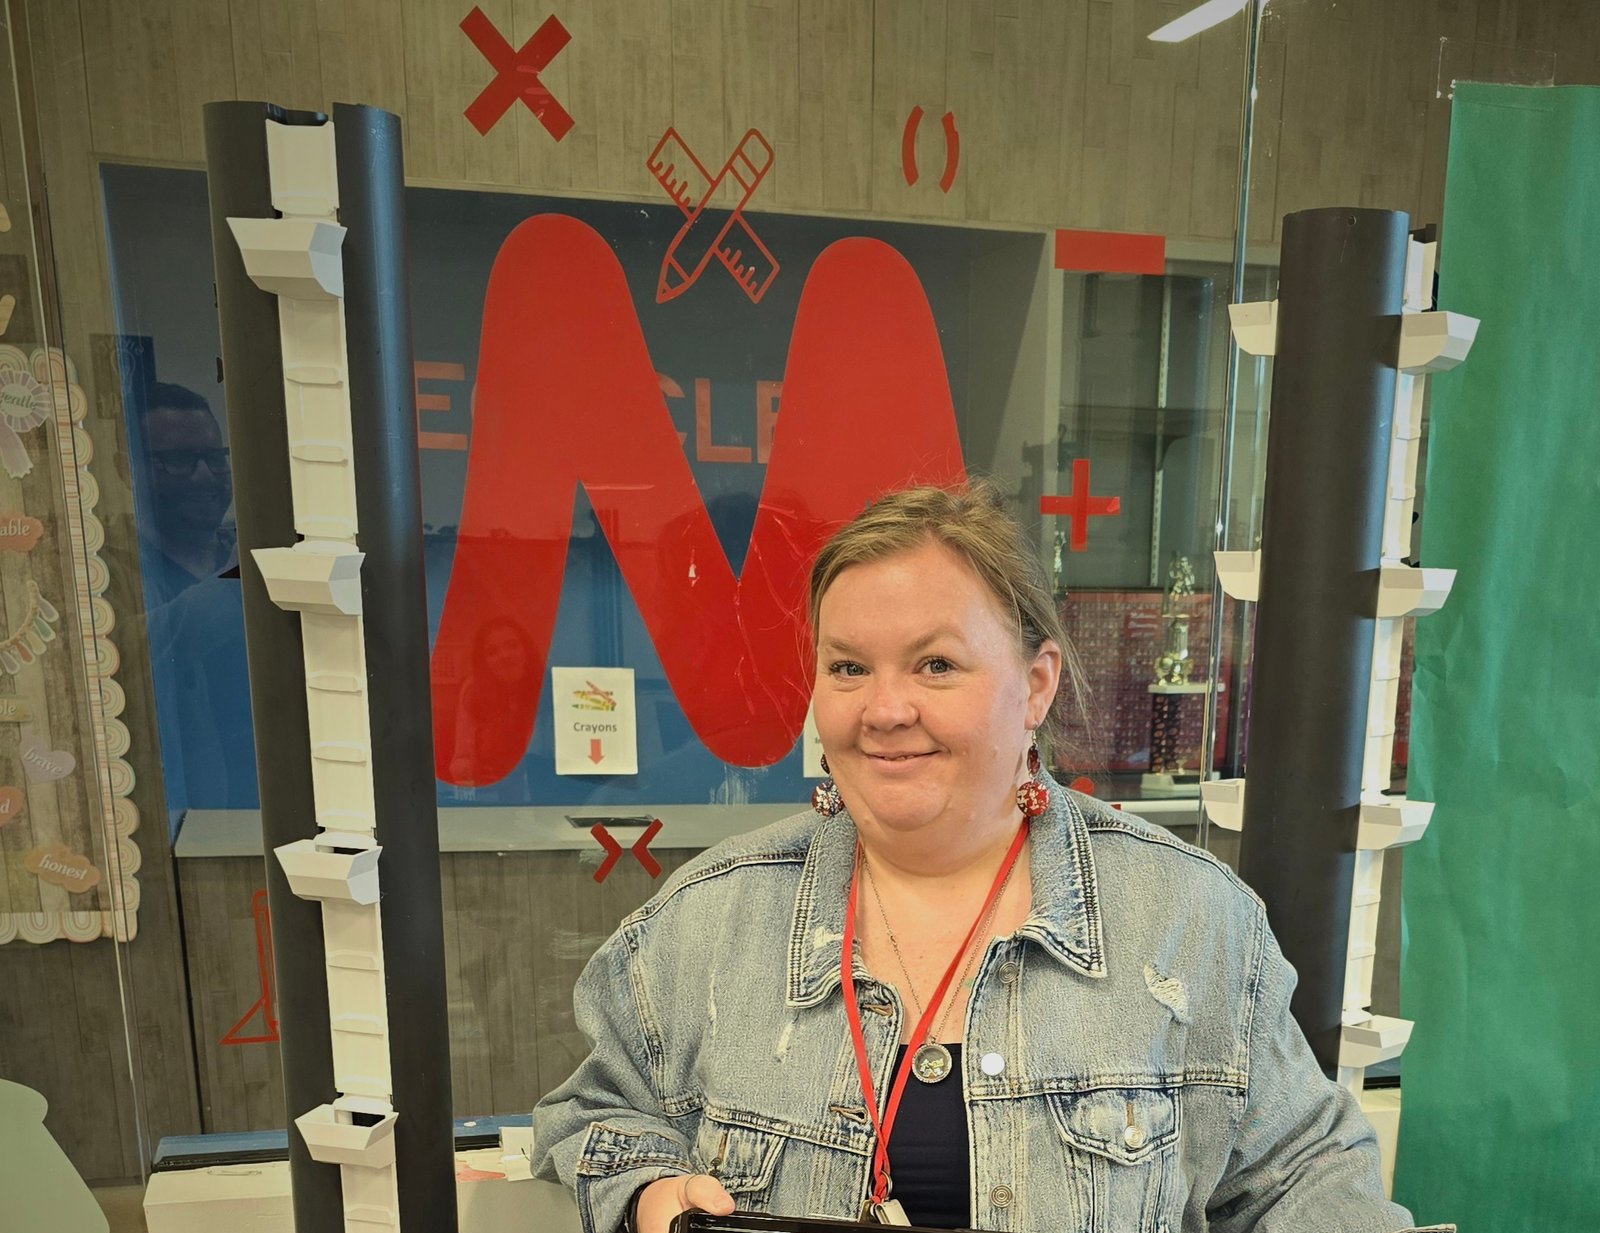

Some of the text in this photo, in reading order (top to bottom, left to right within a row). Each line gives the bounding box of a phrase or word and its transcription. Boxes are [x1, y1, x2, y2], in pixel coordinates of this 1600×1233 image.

[573, 722, 618, 734] Crayons
[24, 747, 64, 775] brave
[39, 854, 88, 881] honest
